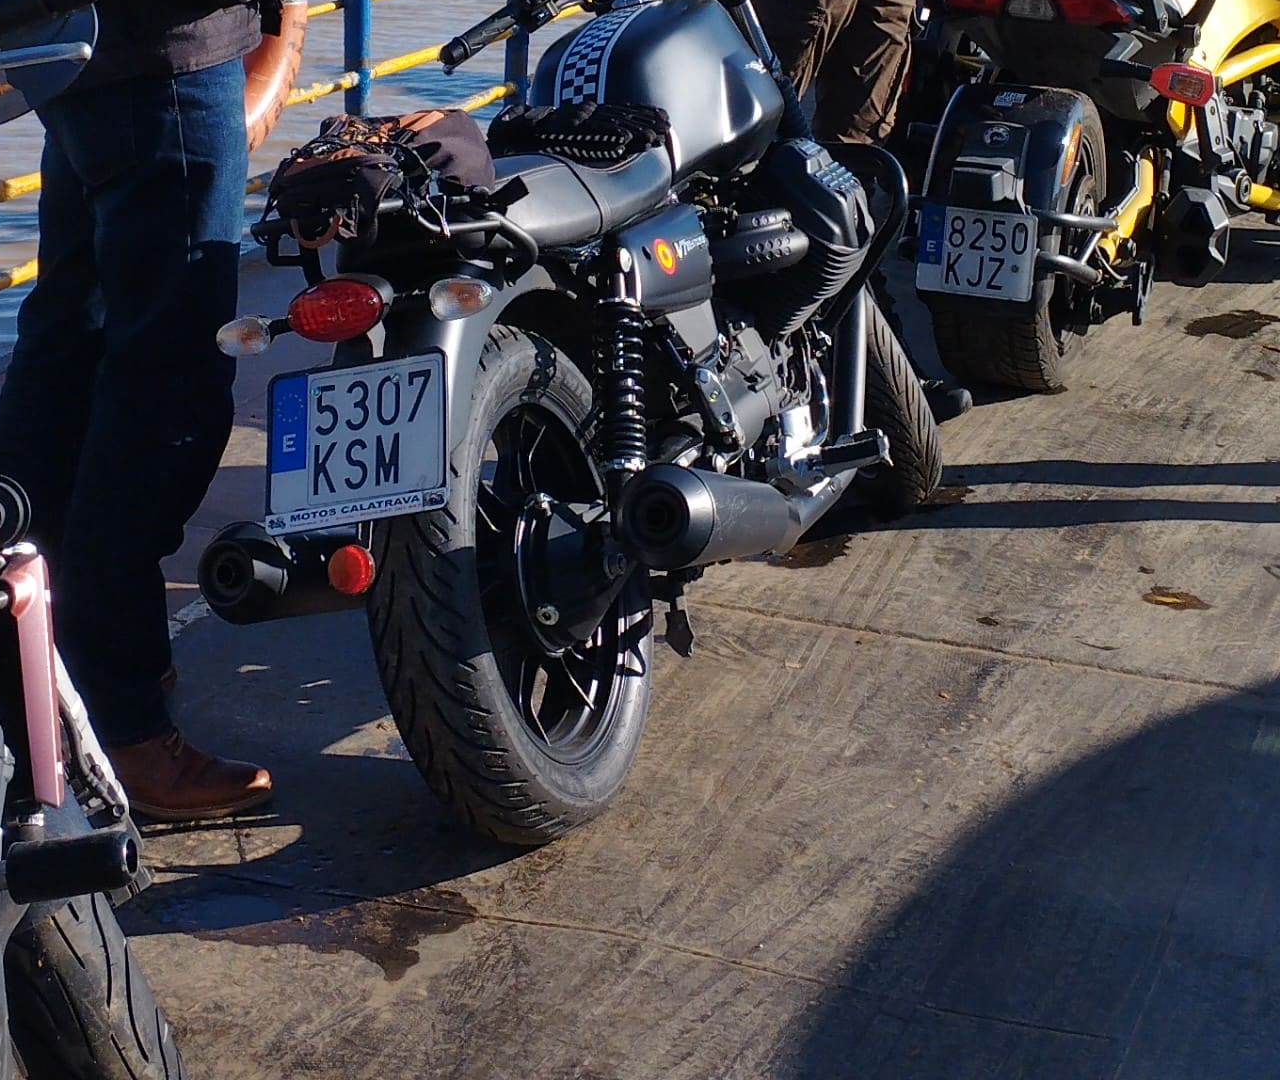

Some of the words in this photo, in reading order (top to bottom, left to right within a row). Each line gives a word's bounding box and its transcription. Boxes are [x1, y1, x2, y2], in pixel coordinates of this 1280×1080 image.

[926, 240, 937, 252] E
[948, 216, 1029, 255] 8250
[944, 252, 1005, 290] KJZ
[315, 368, 432, 436] 5307
[282, 433, 297, 453] E
[313, 432, 400, 496] KSM
[289, 507, 337, 523] MOTOS
[340, 494, 420, 515] CALATRAVA
